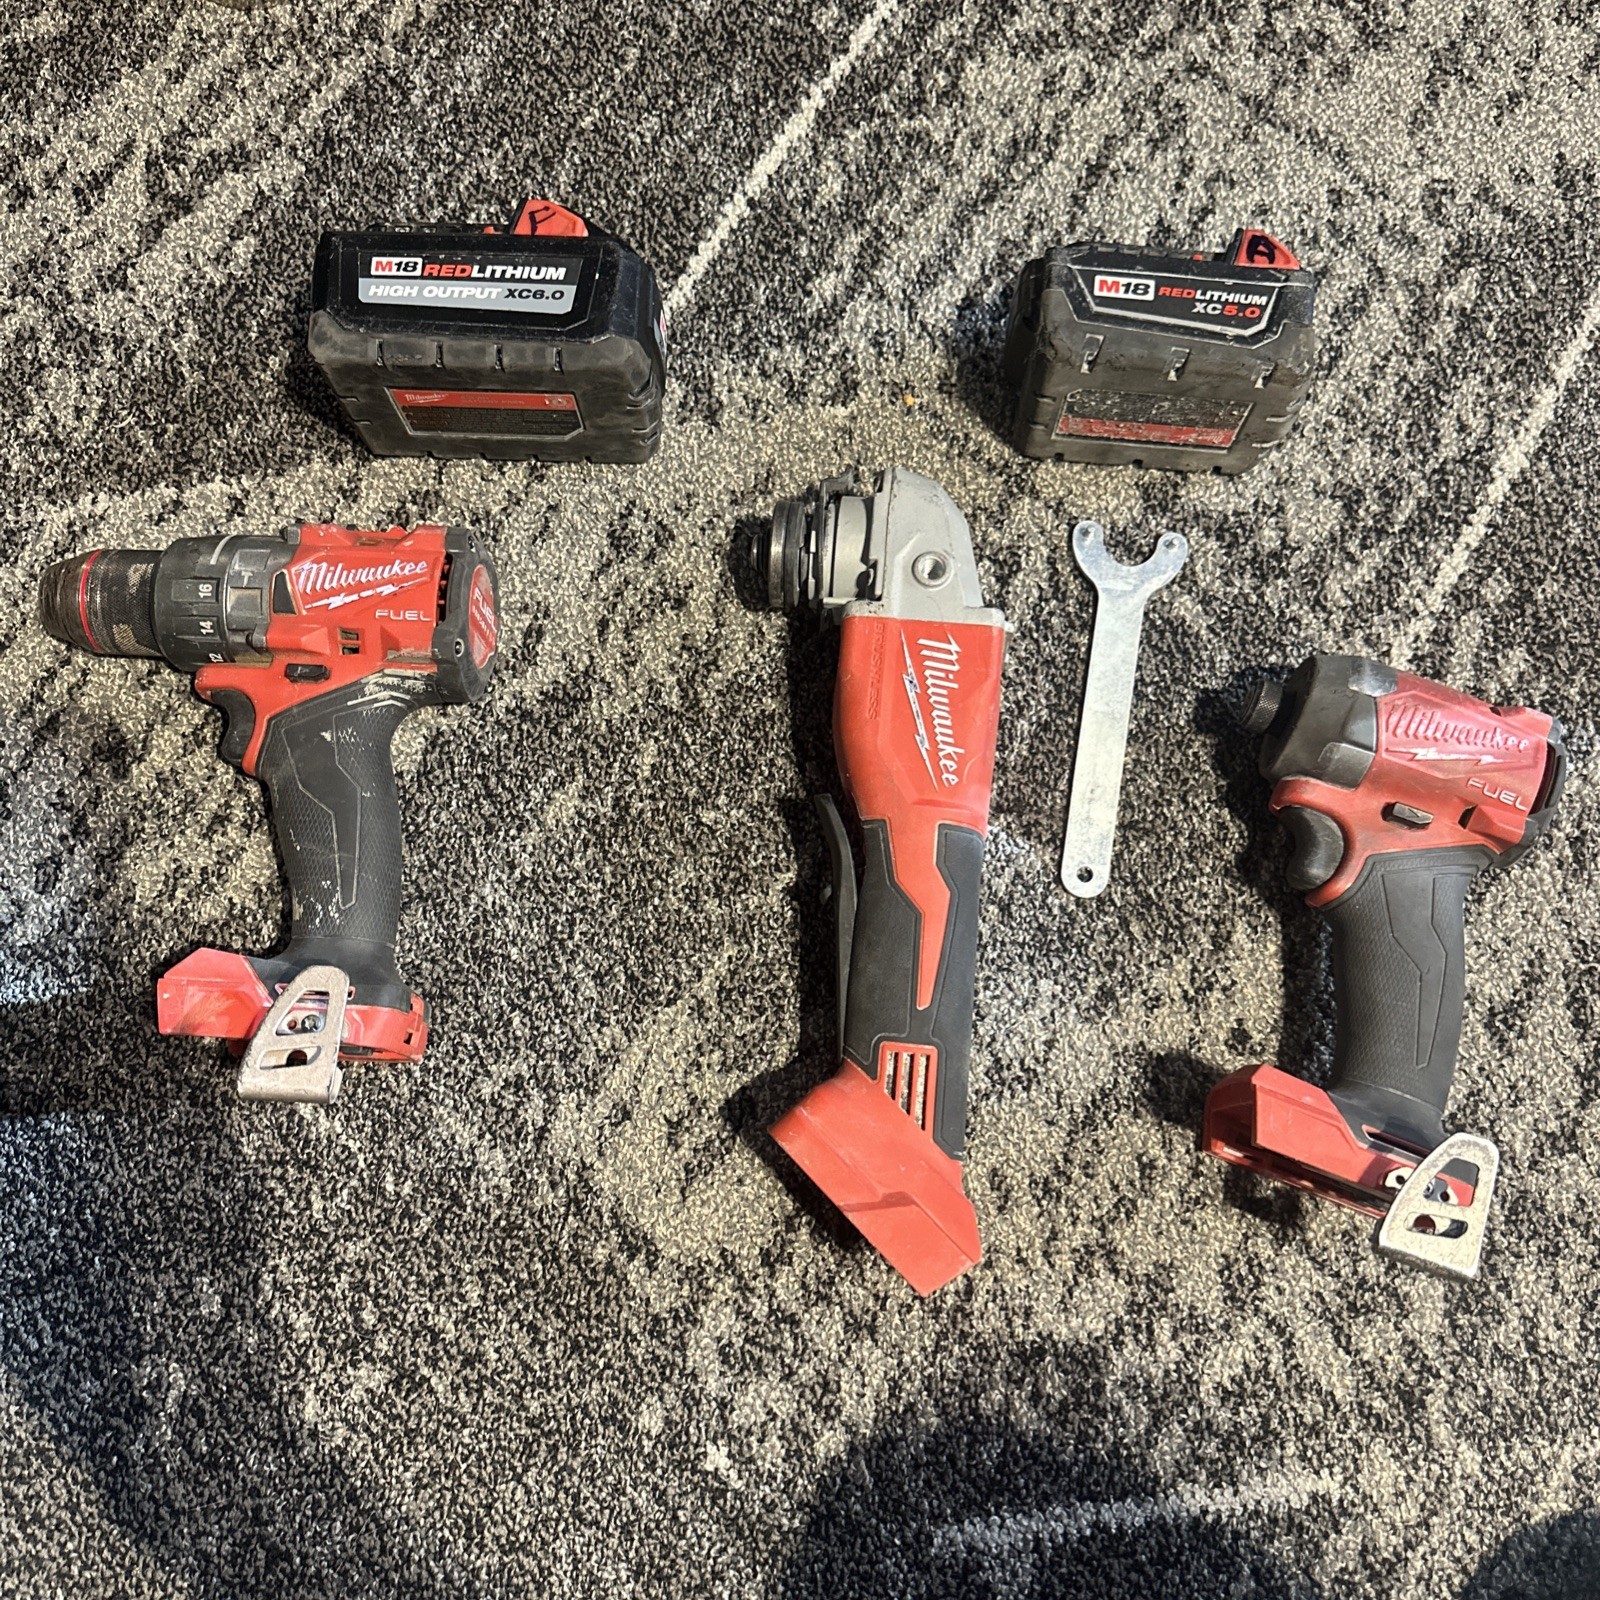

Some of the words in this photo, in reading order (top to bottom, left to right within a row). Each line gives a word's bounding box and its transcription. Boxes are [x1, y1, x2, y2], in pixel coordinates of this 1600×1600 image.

[1246, 234, 1277, 264] A
[374, 260, 419, 273] M18
[423, 263, 567, 281] REDLITHIUM
[368, 285, 420, 298] HIGH
[422, 286, 502, 300] OUTPUT
[504, 288, 565, 301] XC6.0
[1097, 279, 1151, 296] M18
[1158, 286, 1268, 306] REDLITHIUM
[1191, 302, 1261, 319] XC5.0
[298, 559, 429, 595] Milwaukee
[198, 583, 213, 599] 16
[375, 609, 433, 622] FUEL
[473, 587, 498, 634] FUEL
[199, 620, 215, 636] 14
[208, 653, 224, 663] 12
[867, 623, 885, 720] BRUSHLESS
[916, 632, 966, 788] Milwaukee
[1384, 701, 1532, 753] Milwaukee
[1466, 777, 1528, 812] FUEL
